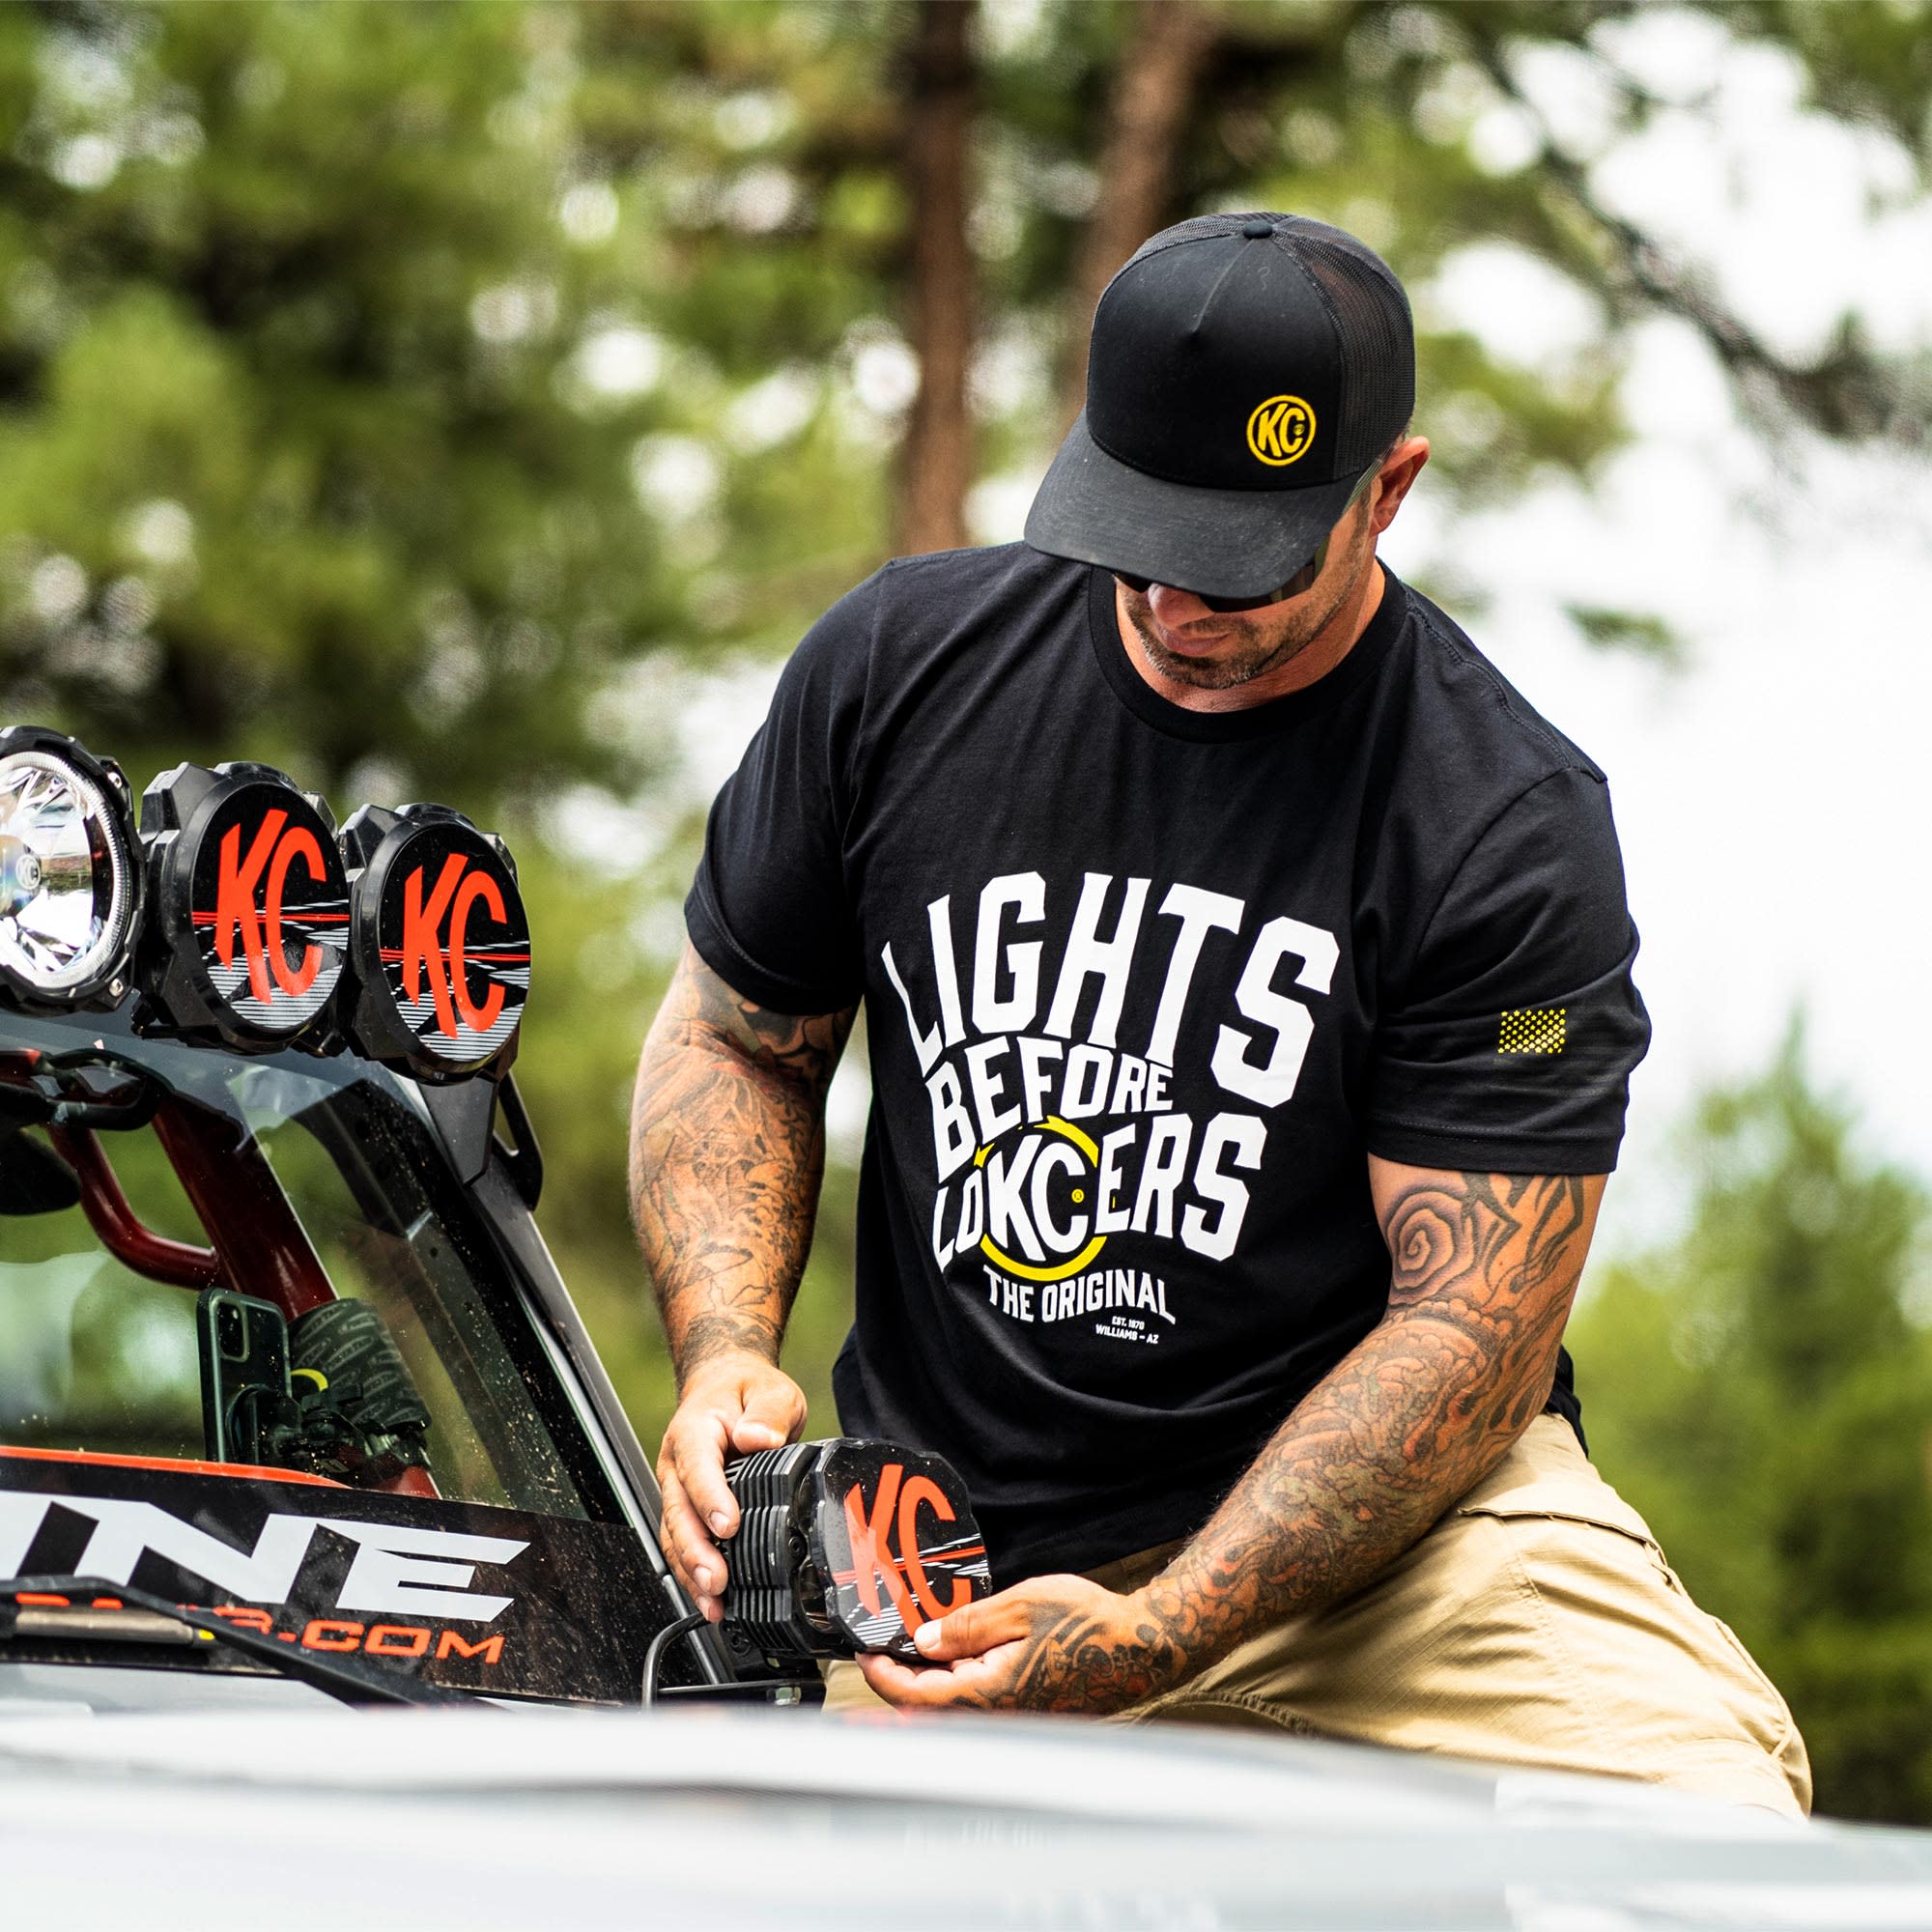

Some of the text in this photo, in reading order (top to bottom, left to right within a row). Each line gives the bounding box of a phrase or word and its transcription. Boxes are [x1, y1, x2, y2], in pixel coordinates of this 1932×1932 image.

[1258, 403, 1305, 457] KC
[215, 809, 327, 1005] KC
[403, 853, 507, 1039] KC
[881, 871, 1340, 1108] LIGHTS
[925, 1036, 1174, 1183] BEFORE
[983, 1264, 1176, 1324] THE ORIGINAL
[1095, 1324, 1137, 1341] WILLIAMS
[1147, 1333, 1159, 1345] AZ
[1112, 1316, 1145, 1330] EST. 1970
[844, 1463, 972, 1639] KC
